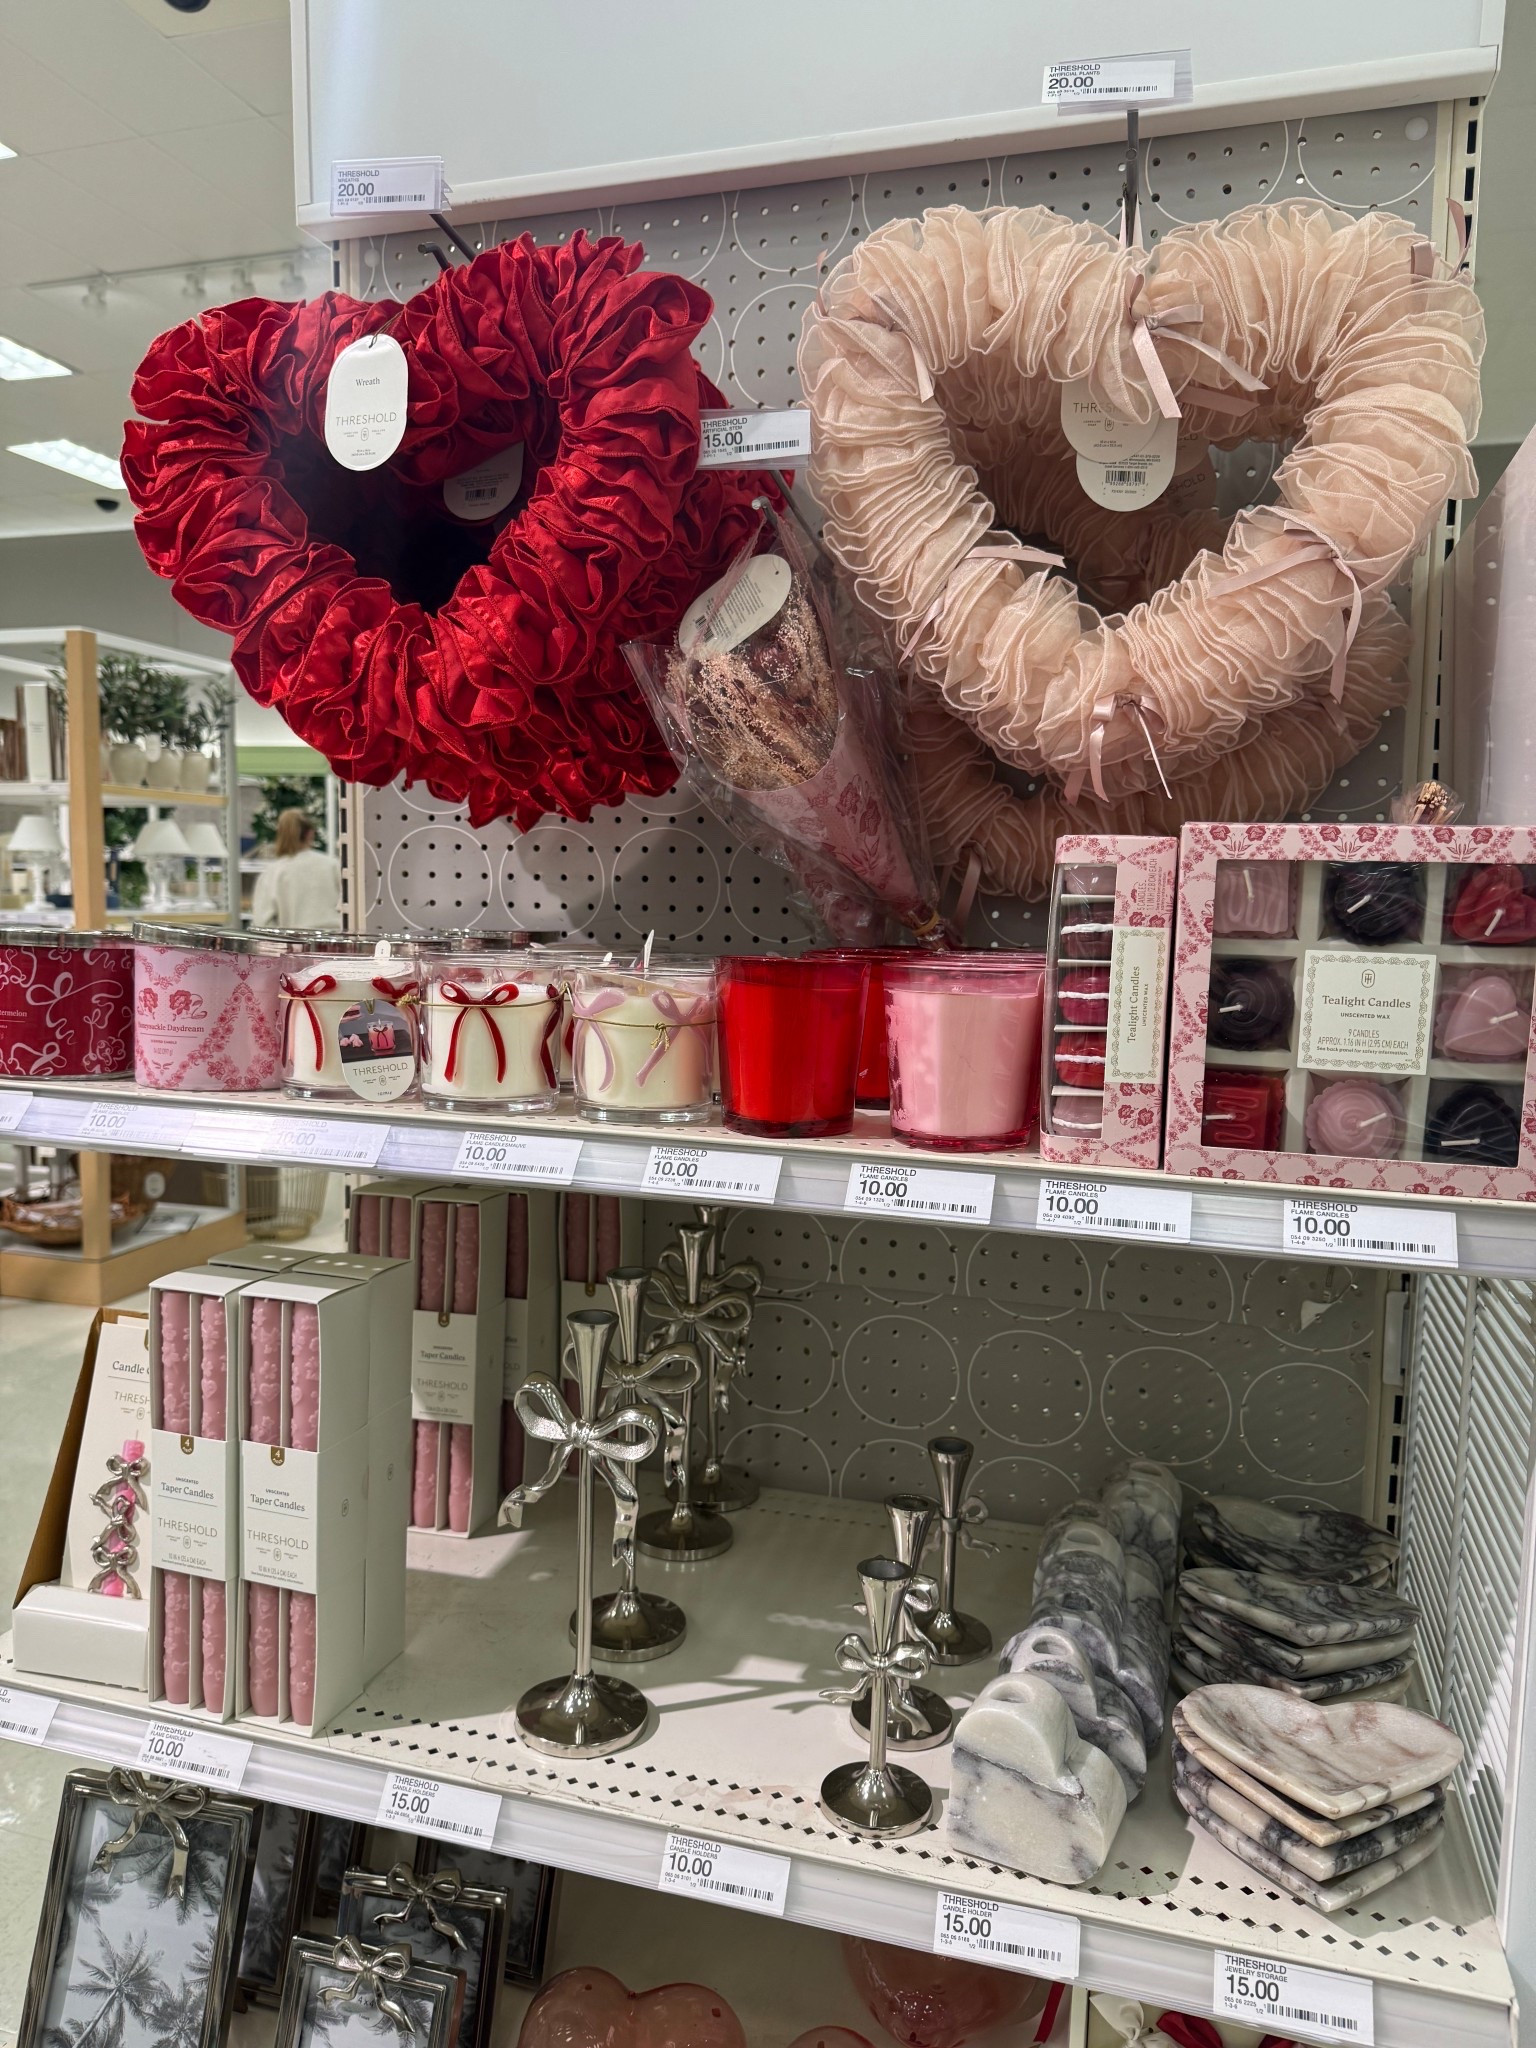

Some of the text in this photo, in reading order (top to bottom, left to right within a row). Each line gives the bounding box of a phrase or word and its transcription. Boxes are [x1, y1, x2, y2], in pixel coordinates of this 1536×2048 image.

[1050, 64, 1100, 72] THRESHOLD
[1049, 76, 1093, 89] 20.00
[338, 183, 374, 196] 20.00
[356, 377, 380, 386] Wreath
[336, 412, 397, 426] THRESHOLD
[702, 417, 747, 428] THRESHOLD
[704, 431, 743, 448] 15.00
[1127, 966, 1139, 1043] Tealight Candles
[1322, 995, 1411, 1008] Tealight Candles
[167, 1024, 204, 1032] Daydream
[1353, 1029, 1379, 1038] CANDLES
[1393, 1041, 1408, 1049] EACH
[353, 1062, 408, 1076] THRESHOLD
[96, 1103, 138, 1111] THRESHOLD
[89, 1114, 126, 1128] 10.00
[277, 1131, 315, 1145] 10.00
[469, 1133, 517, 1142] THRESHOLD
[465, 1146, 506, 1161] 10.00
[656, 1148, 707, 1157] THRESHOLD
[654, 1161, 697, 1177] 10.00
[861, 1166, 916, 1176] THRESHOLD
[860, 1180, 907, 1197] 10.00
[1046, 1181, 1107, 1192] THRESHOLD
[1068, 1190, 1098, 1198] CANDLES
[1046, 1196, 1098, 1215] 10.00
[1291, 1200, 1358, 1213] THRESHOLD
[1317, 1211, 1349, 1219] CANDLES
[1293, 1217, 1350, 1236] 10.00
[421, 1350, 466, 1361] Taper Candles
[112, 1361, 144, 1374] Candle
[417, 1378, 468, 1391] THRESHOLD
[184, 1439, 190, 1447] 4
[275, 1450, 280, 1458] 4
[161, 1482, 214, 1499] Taper Candles
[250, 1493, 305, 1511] Taper Candles
[158, 1517, 217, 1537] THRESHOLD
[247, 1529, 309, 1550] THRESHOLD
[166, 1734, 186, 1742] CANDLES
[148, 1737, 183, 1757] 10.00
[395, 1775, 439, 1792] THRESHOLD
[393, 1784, 435, 1798] CANDLE HOLDERS
[391, 1791, 430, 1814] 15.00
[671, 1836, 721, 1853] THRESHOLD
[669, 1845, 717, 1859] CANDLE HOLDERS
[669, 1853, 712, 1877] 10.00
[943, 1894, 999, 1912] THRESHOLD
[942, 1904, 992, 1918] CANDLE HOLDER
[944, 1913, 991, 1937] 15.00
[1225, 1955, 1287, 1974] THRESHOLD
[1225, 1966, 1288, 1983] JEWELRY STORAGE
[1226, 1974, 1279, 2002] 15.00
